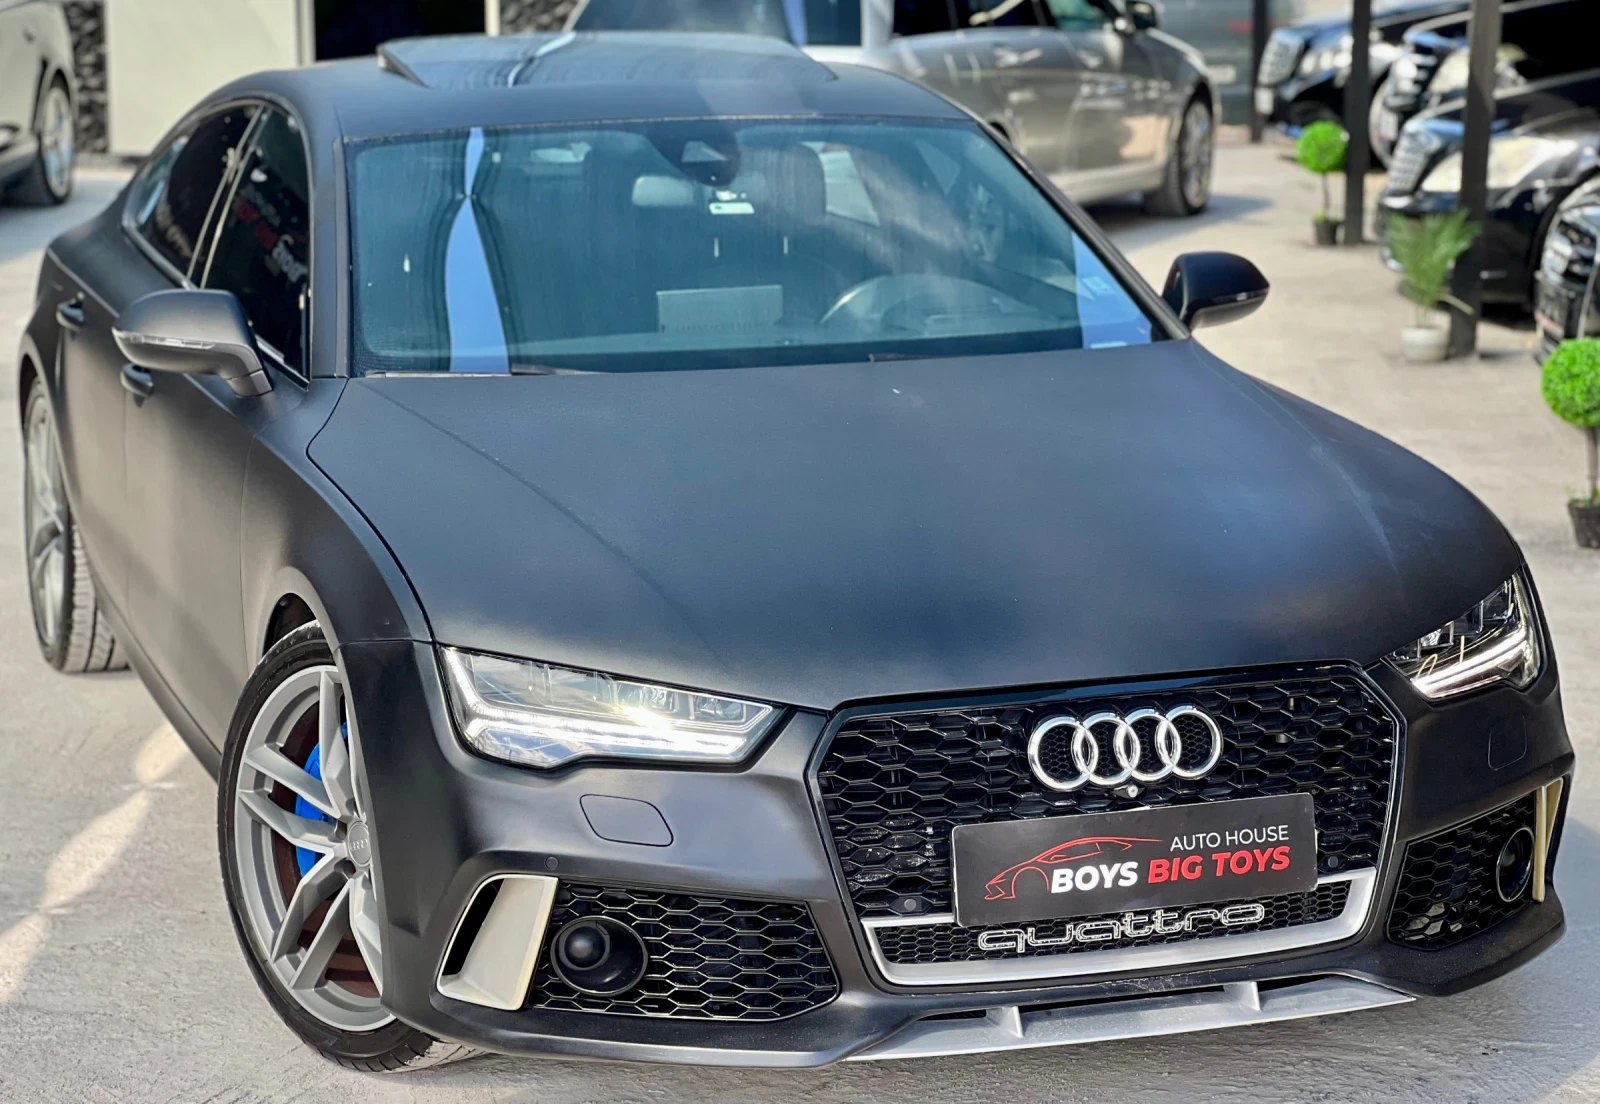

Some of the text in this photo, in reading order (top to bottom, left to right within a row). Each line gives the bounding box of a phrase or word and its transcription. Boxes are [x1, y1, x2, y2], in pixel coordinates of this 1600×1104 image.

[1170, 825, 1289, 852] AUTO HOUSE
[1050, 845, 1291, 894] BOYS BIG TOYS
[978, 903, 1266, 953] quattro
